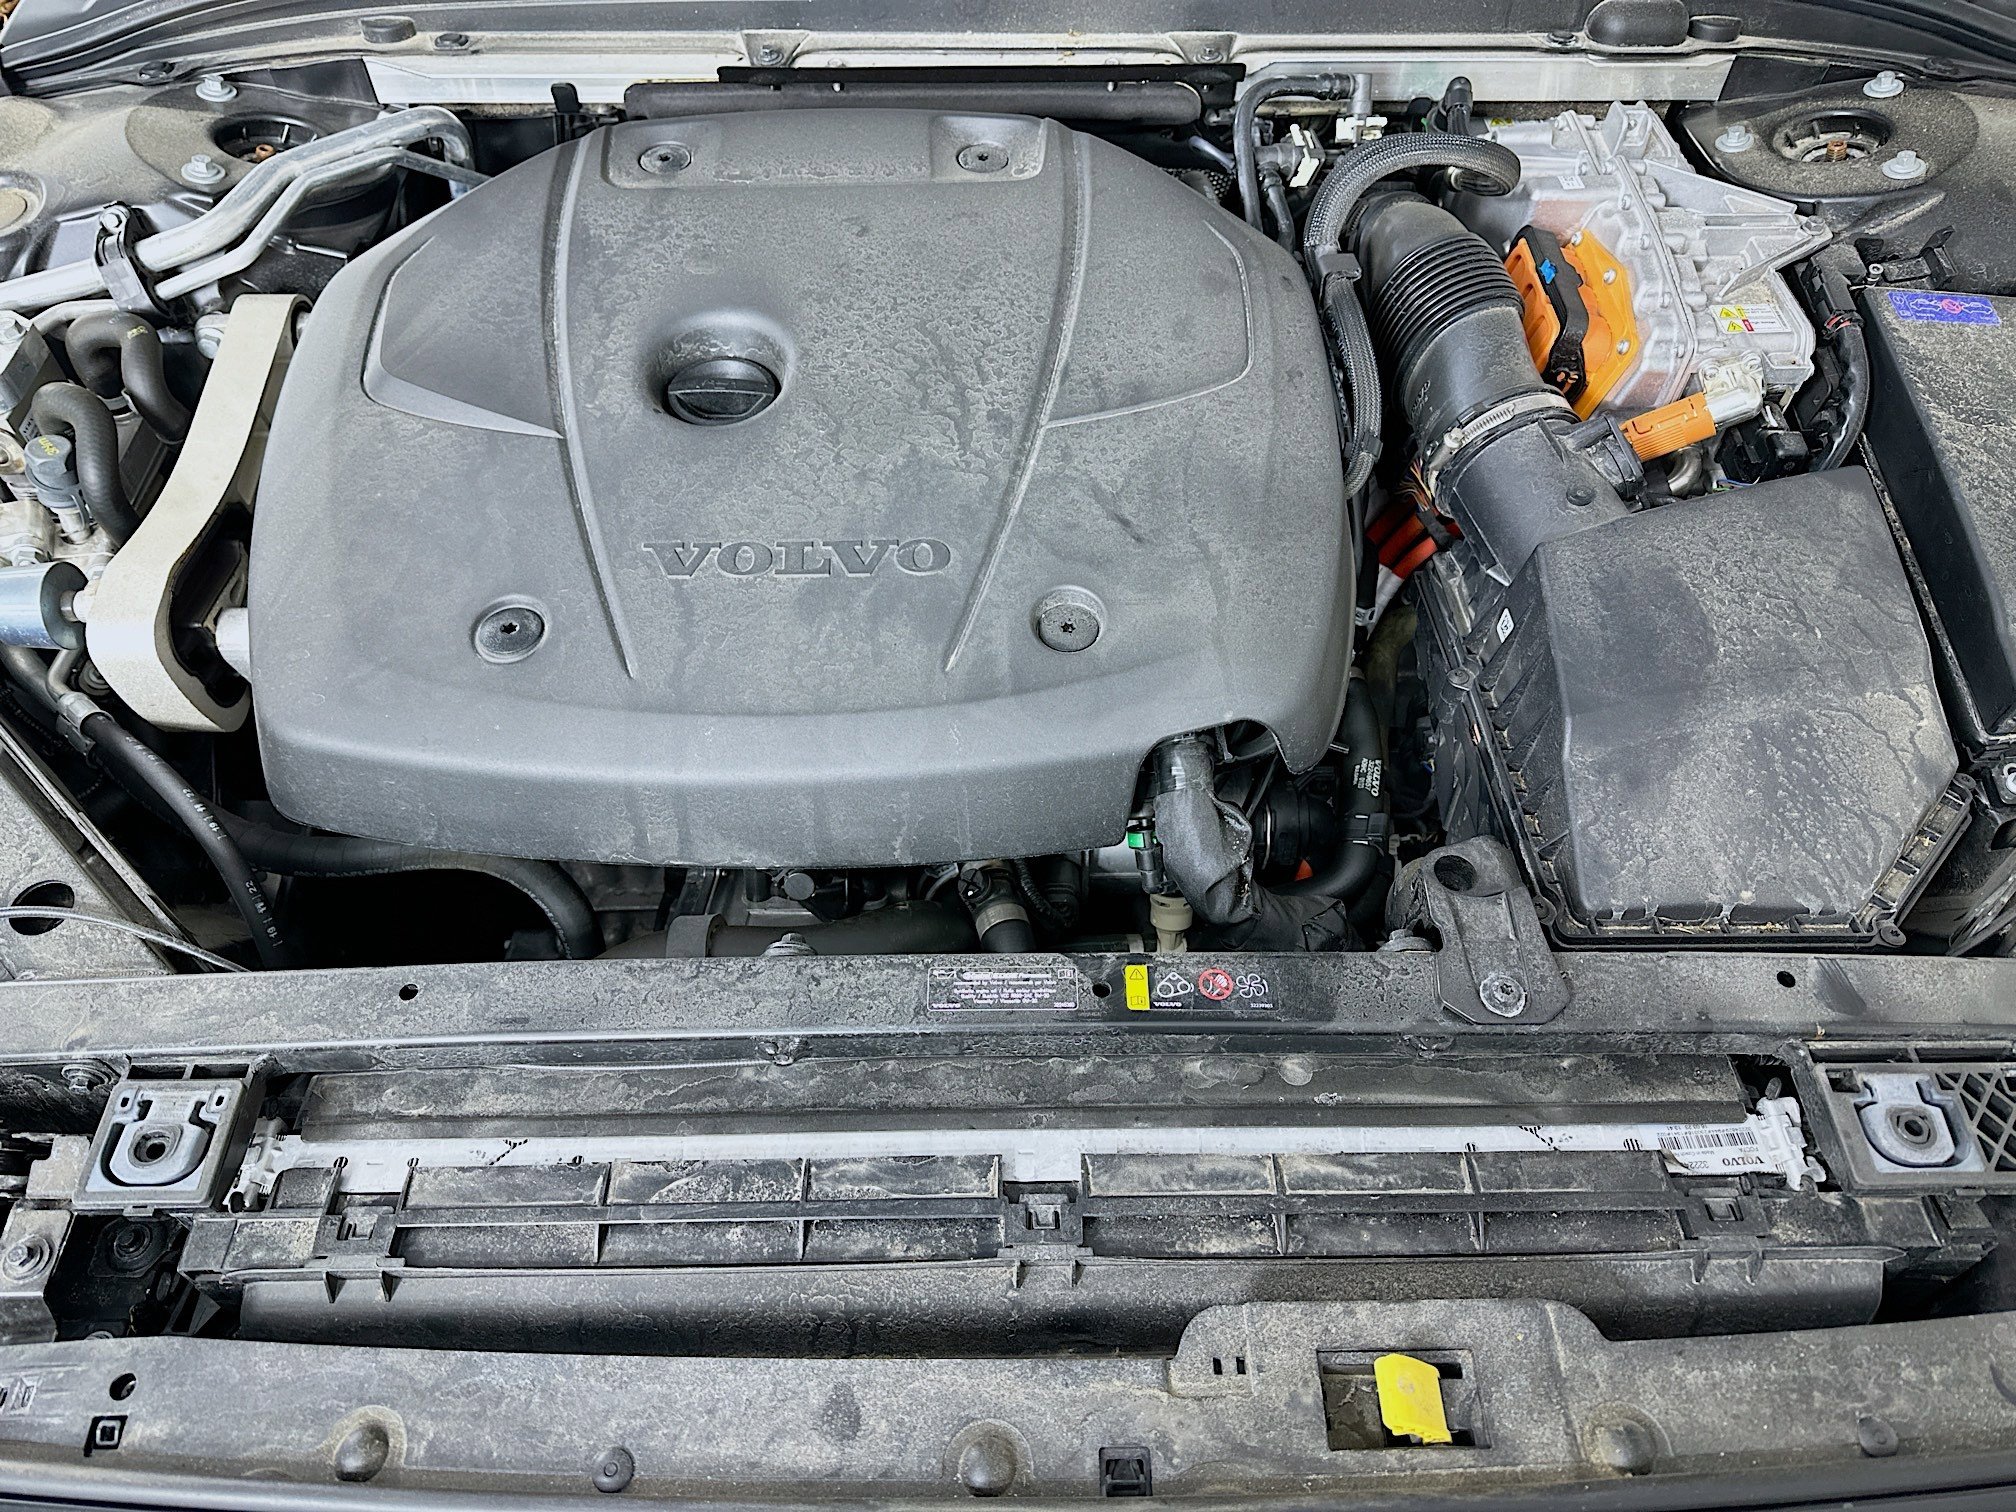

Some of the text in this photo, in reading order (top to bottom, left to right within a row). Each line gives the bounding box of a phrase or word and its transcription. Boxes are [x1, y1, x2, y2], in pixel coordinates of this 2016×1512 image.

[642, 537, 951, 578] VOLVO
[1371, 760, 1382, 797] VOLVO
[1722, 1156, 1765, 1166] VOLVO
